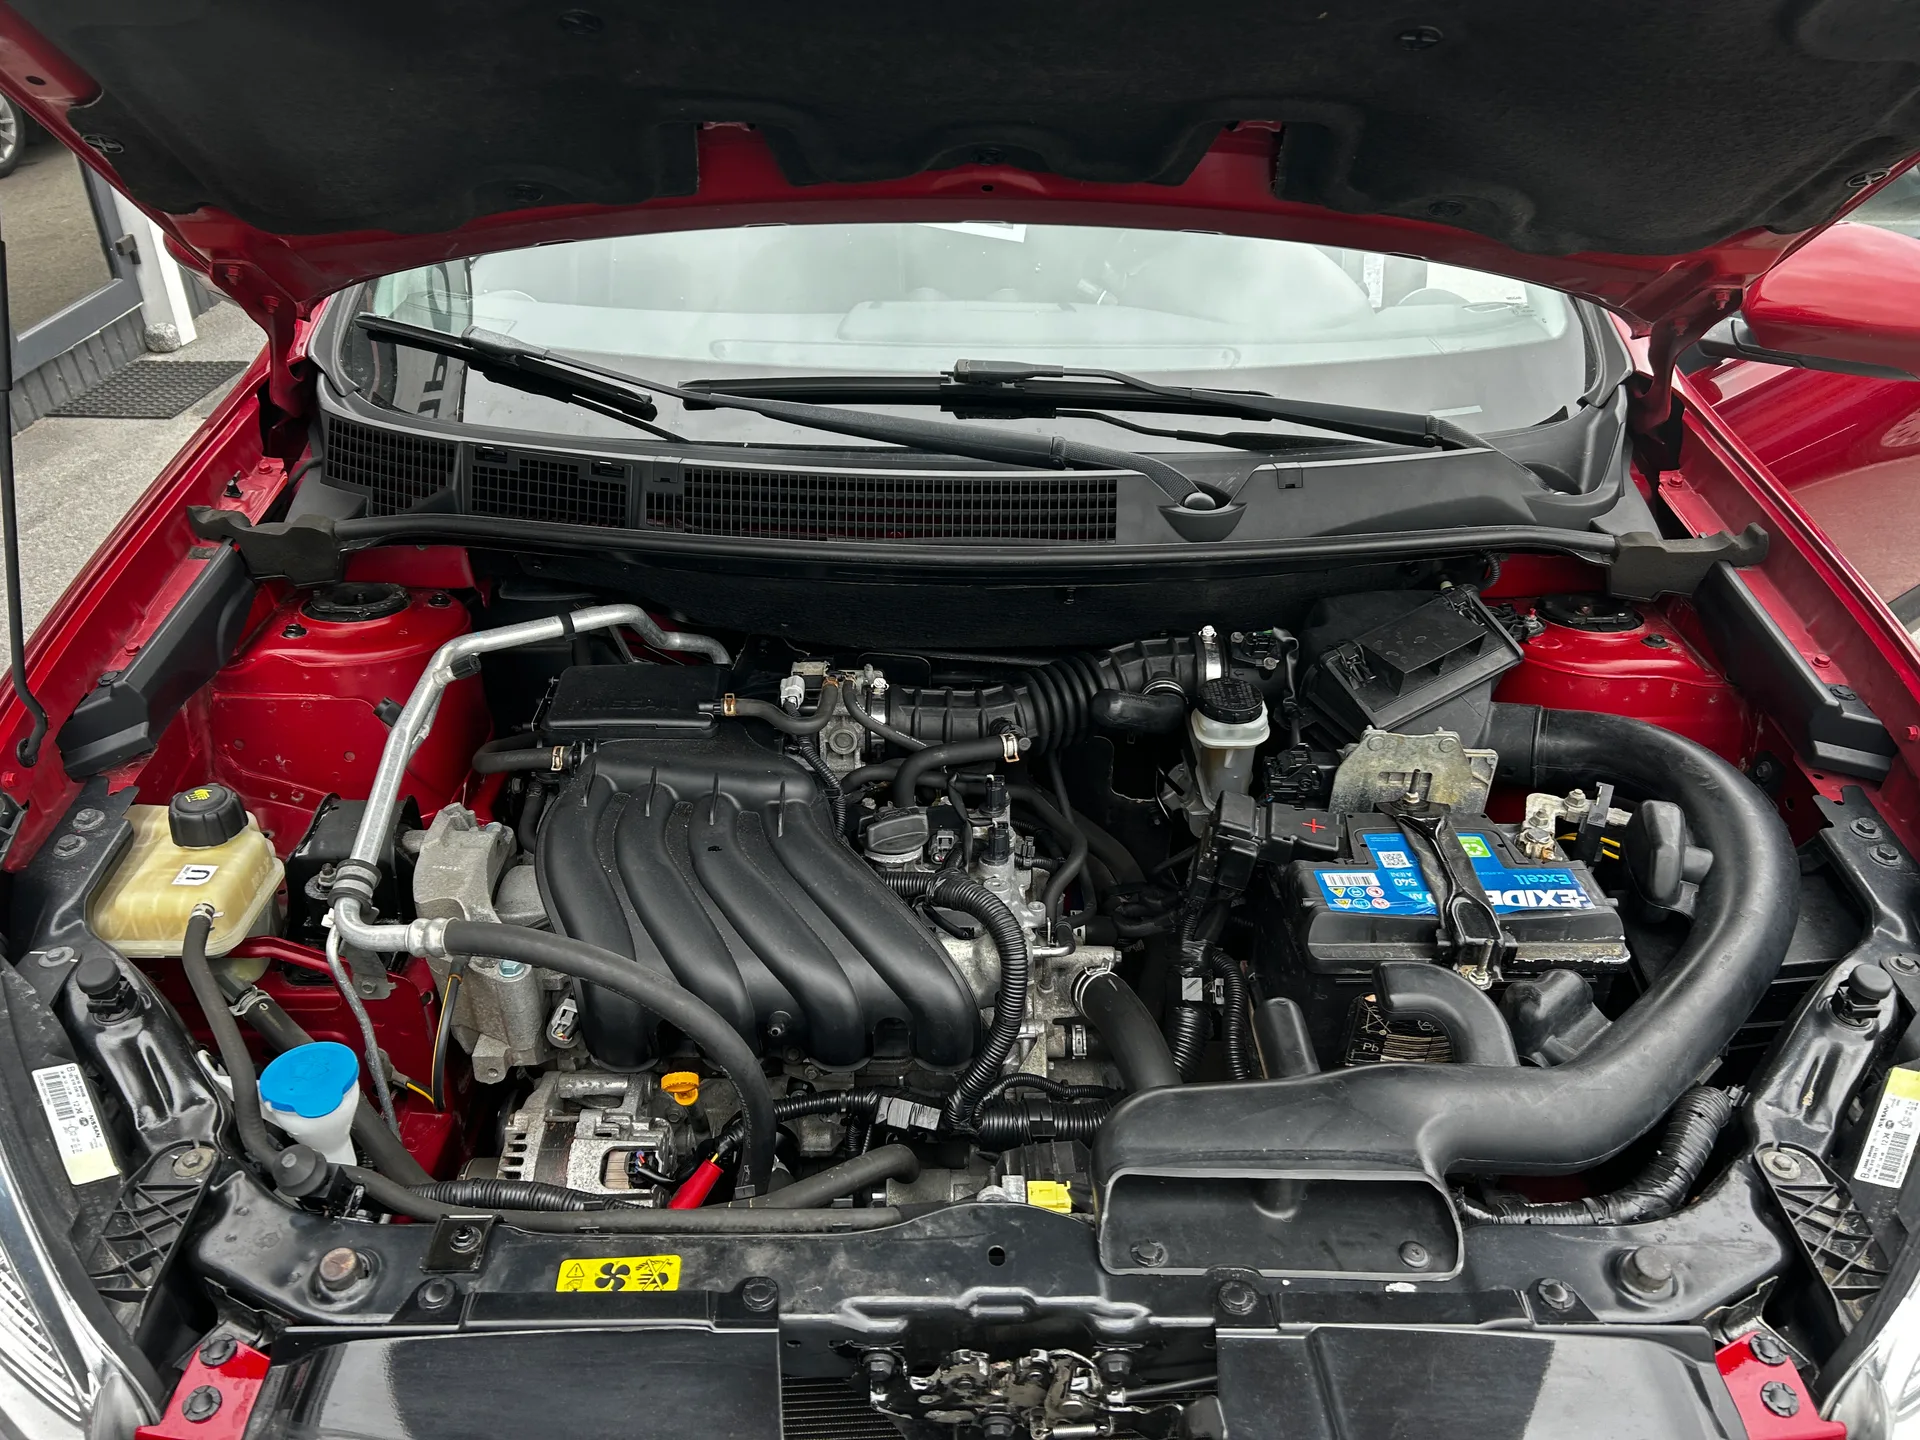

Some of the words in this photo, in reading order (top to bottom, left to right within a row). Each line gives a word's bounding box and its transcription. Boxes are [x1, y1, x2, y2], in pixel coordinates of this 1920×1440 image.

[1393, 878, 1418, 887] 540
[1513, 874, 1572, 885] Excell
[1485, 889, 1587, 907] EXIDE
[1362, 1042, 1379, 1052] Pb
[1878, 1104, 1890, 1128] NISSAN
[88, 1114, 101, 1138] NISSAN
